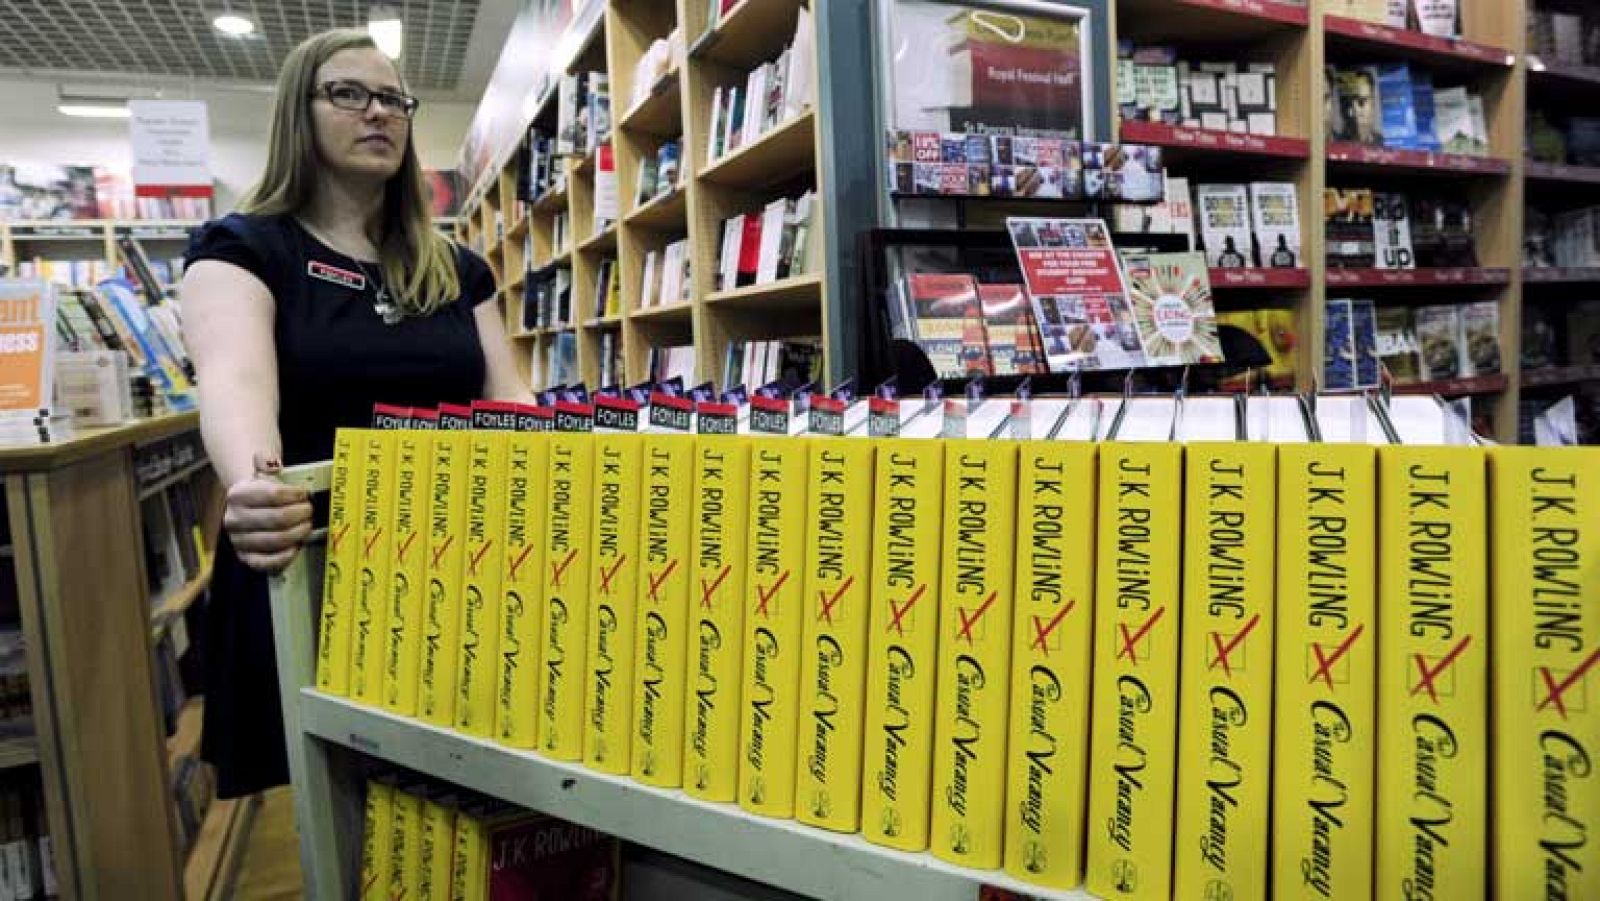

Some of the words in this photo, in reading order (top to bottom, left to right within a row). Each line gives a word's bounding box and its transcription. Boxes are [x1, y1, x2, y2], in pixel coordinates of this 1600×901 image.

[987, 66, 1015, 84] Royal
[475, 412, 515, 428] FOYLES
[597, 407, 635, 427] FOYLES
[652, 405, 688, 427] FOYLES
[699, 417, 735, 434] FOYLES
[752, 411, 788, 429] FOYLES
[699, 618, 721, 682] Casual
[754, 627, 778, 692] Casual
[816, 634, 842, 703] Casual
[887, 645, 915, 716] Casual
[956, 654, 986, 729] Casual
[1030, 664, 1062, 742] Casual
[1117, 675, 1153, 755] Casual
[1209, 686, 1248, 772] Casual
[1310, 700, 1353, 791] Casual
[1412, 713, 1459, 807] Casual
[1539, 729, 1592, 830] Casual
